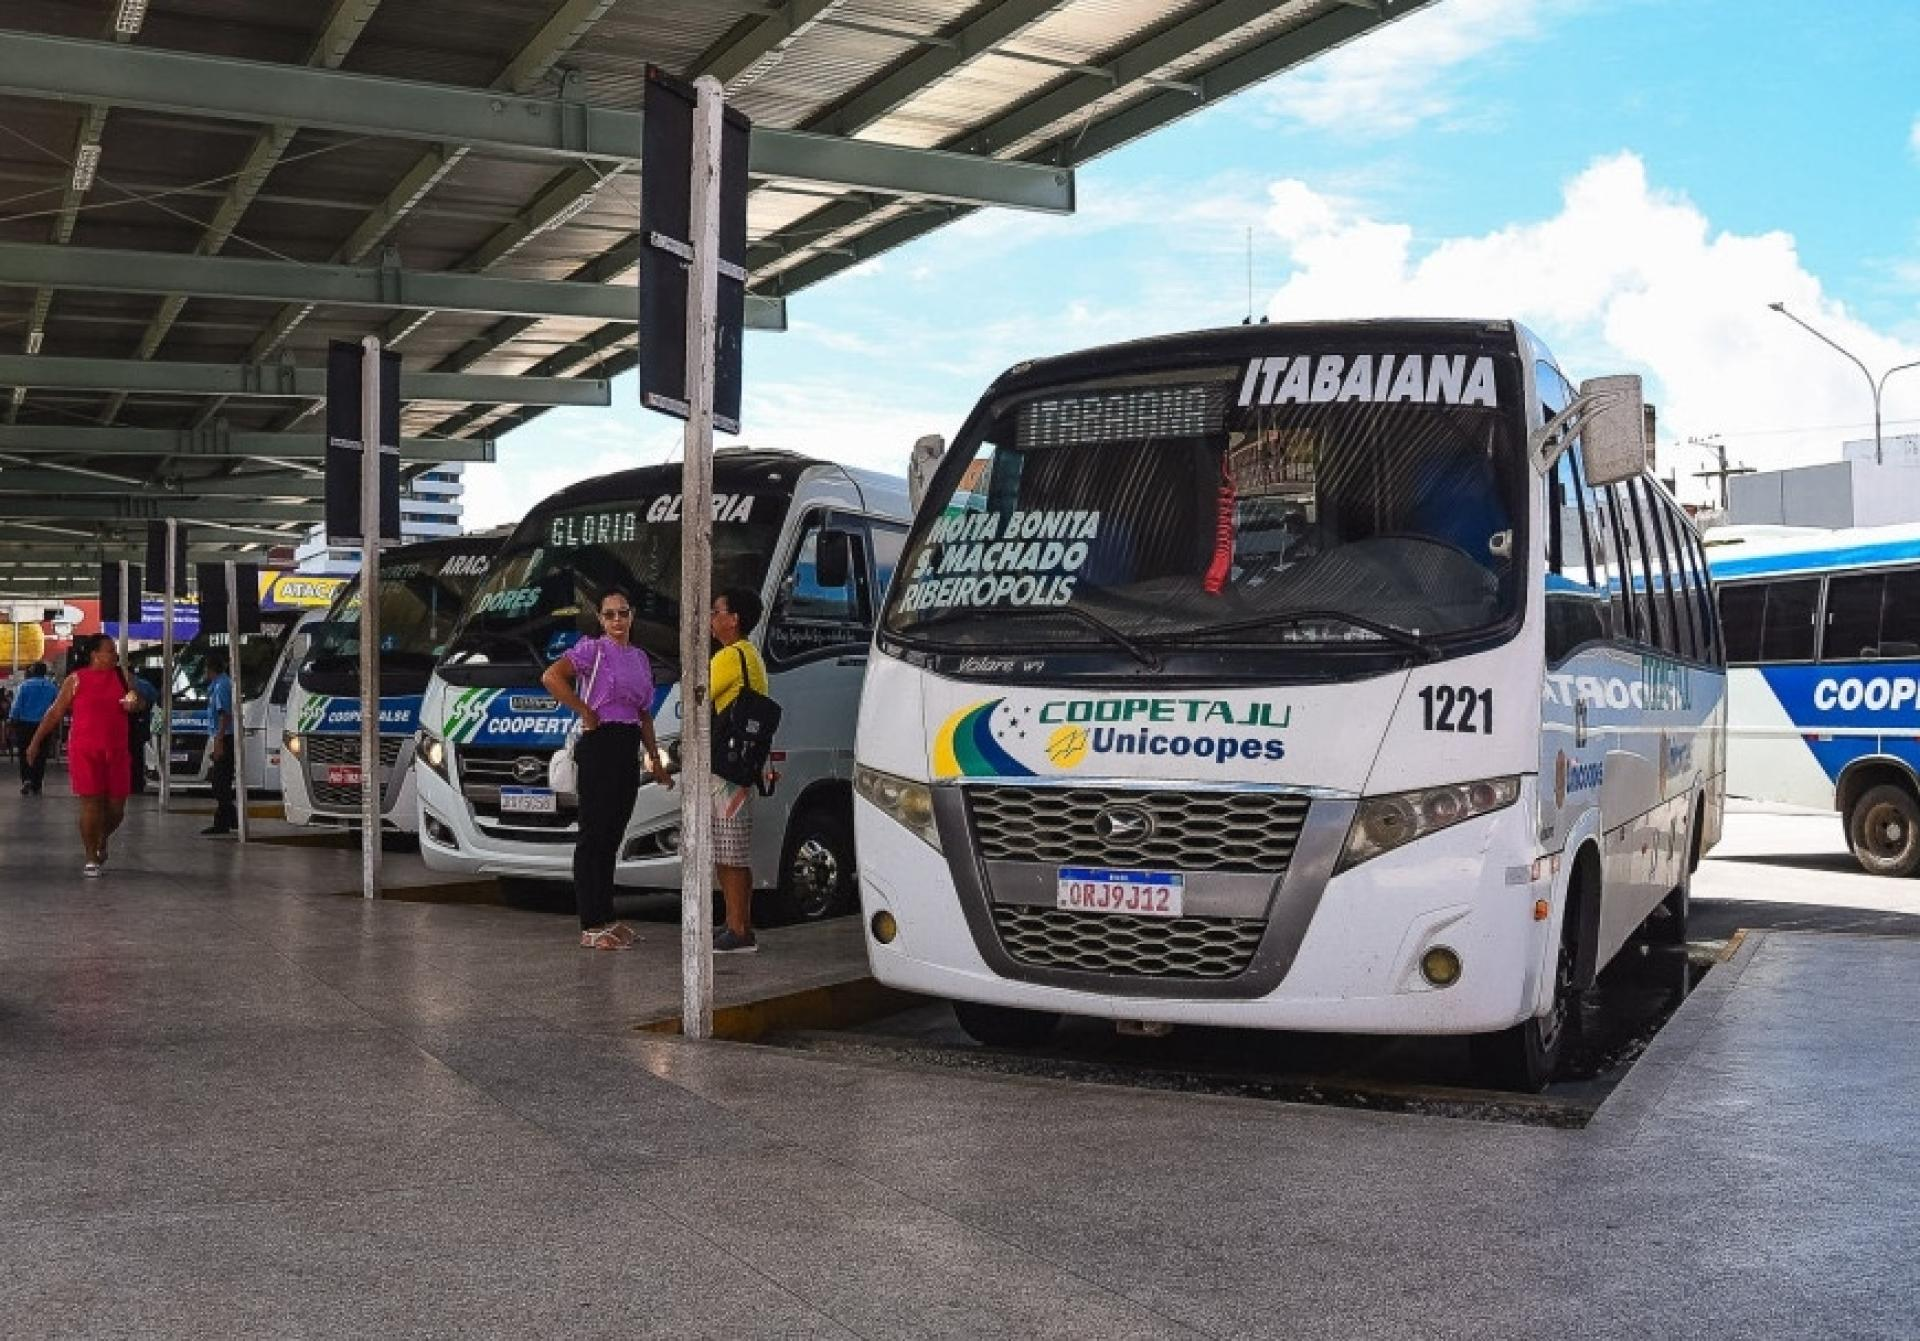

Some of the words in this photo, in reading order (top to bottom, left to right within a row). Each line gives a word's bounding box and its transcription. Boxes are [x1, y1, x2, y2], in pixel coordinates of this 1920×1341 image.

[1237, 354, 1497, 407] ITABAIANA
[646, 493, 756, 523] GLRIA
[551, 511, 637, 546] GLORIA
[924, 513, 1000, 546] MOITA
[1003, 511, 1100, 539] BONITA
[937, 542, 1089, 574] MACHADO
[959, 656, 1015, 672] Volare
[328, 709, 411, 723] COOPEALSE
[1039, 698, 1291, 728] COOPETAJU
[1419, 685, 1494, 735] 1221
[1092, 727, 1286, 763] Unicoopes
[1069, 882, 1169, 911] ORJ9J12
